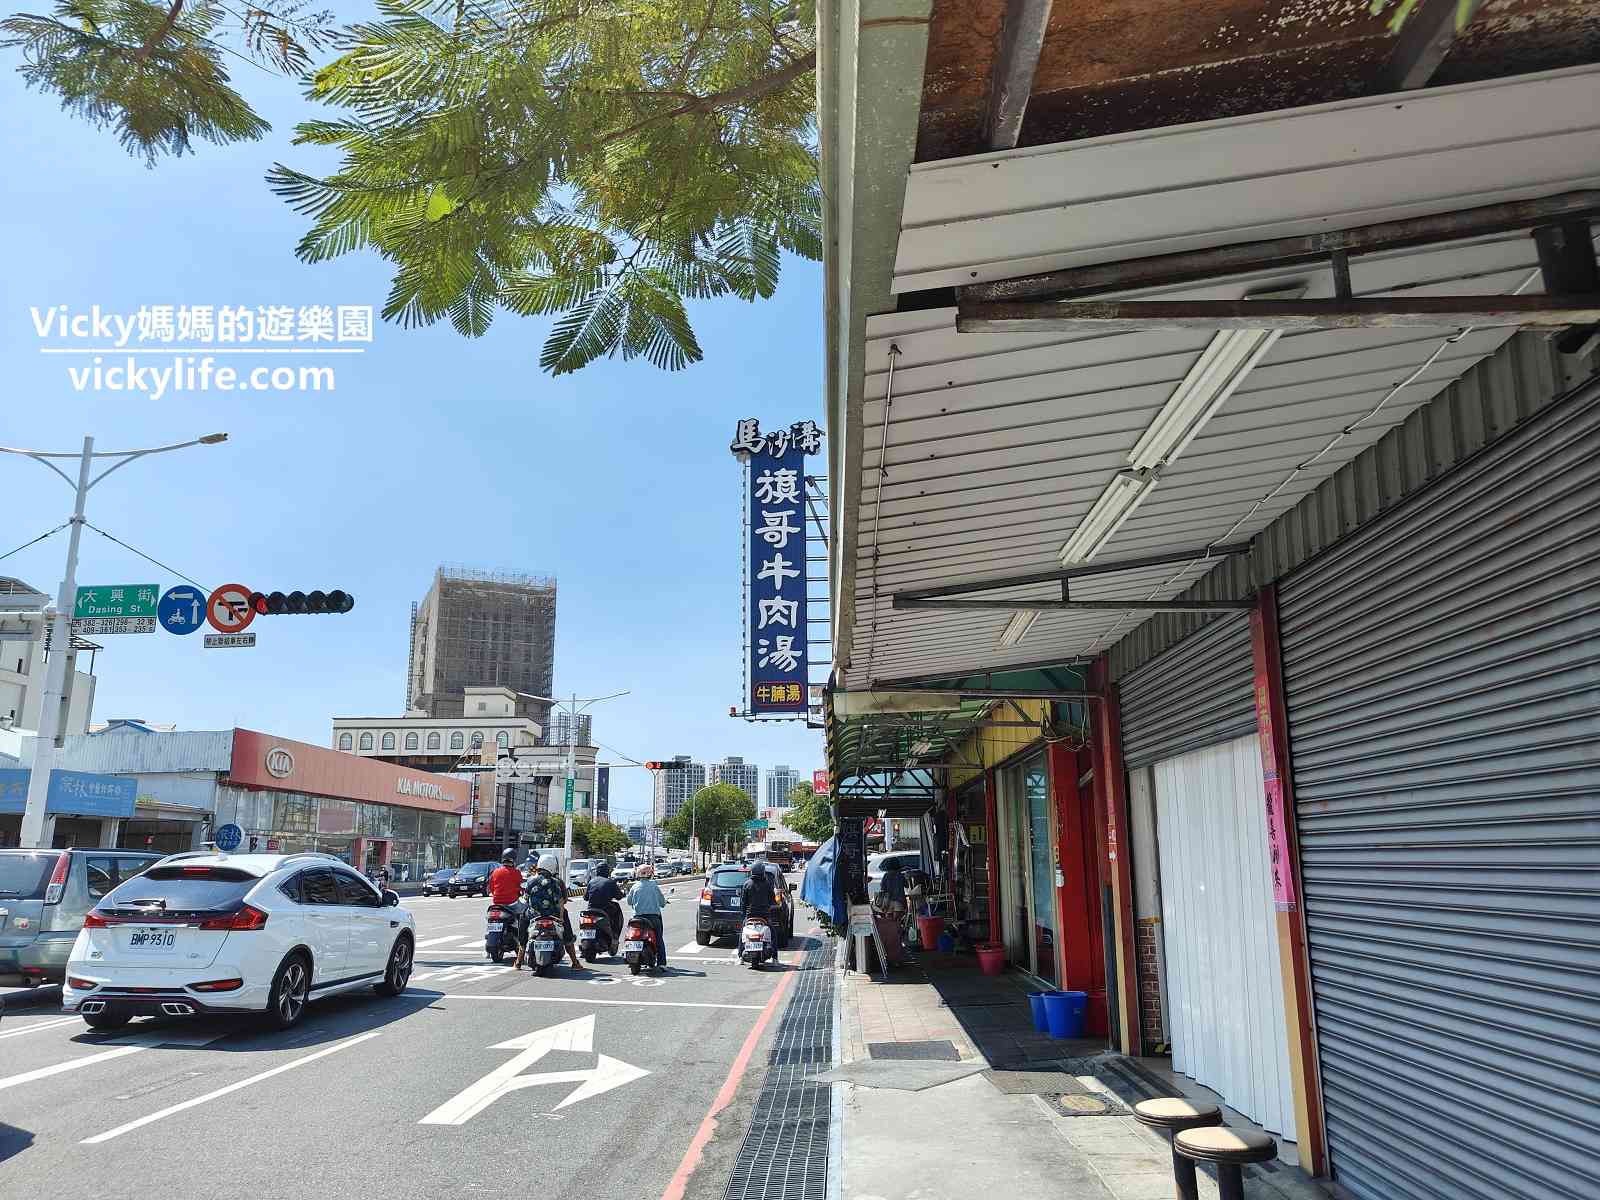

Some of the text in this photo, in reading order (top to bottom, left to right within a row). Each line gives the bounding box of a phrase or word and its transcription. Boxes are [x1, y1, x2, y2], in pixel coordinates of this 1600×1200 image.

[732, 419, 820, 458] 馬沙溝
[754, 467, 802, 674] 旗哥牛肉湯
[84, 588, 152, 603] 大興街
[88, 604, 143, 615] Dasing St.
[757, 684, 800, 702] 牛腩湯
[412, 781, 443, 800] MOTORS
[130, 932, 176, 947] BMP-9310
